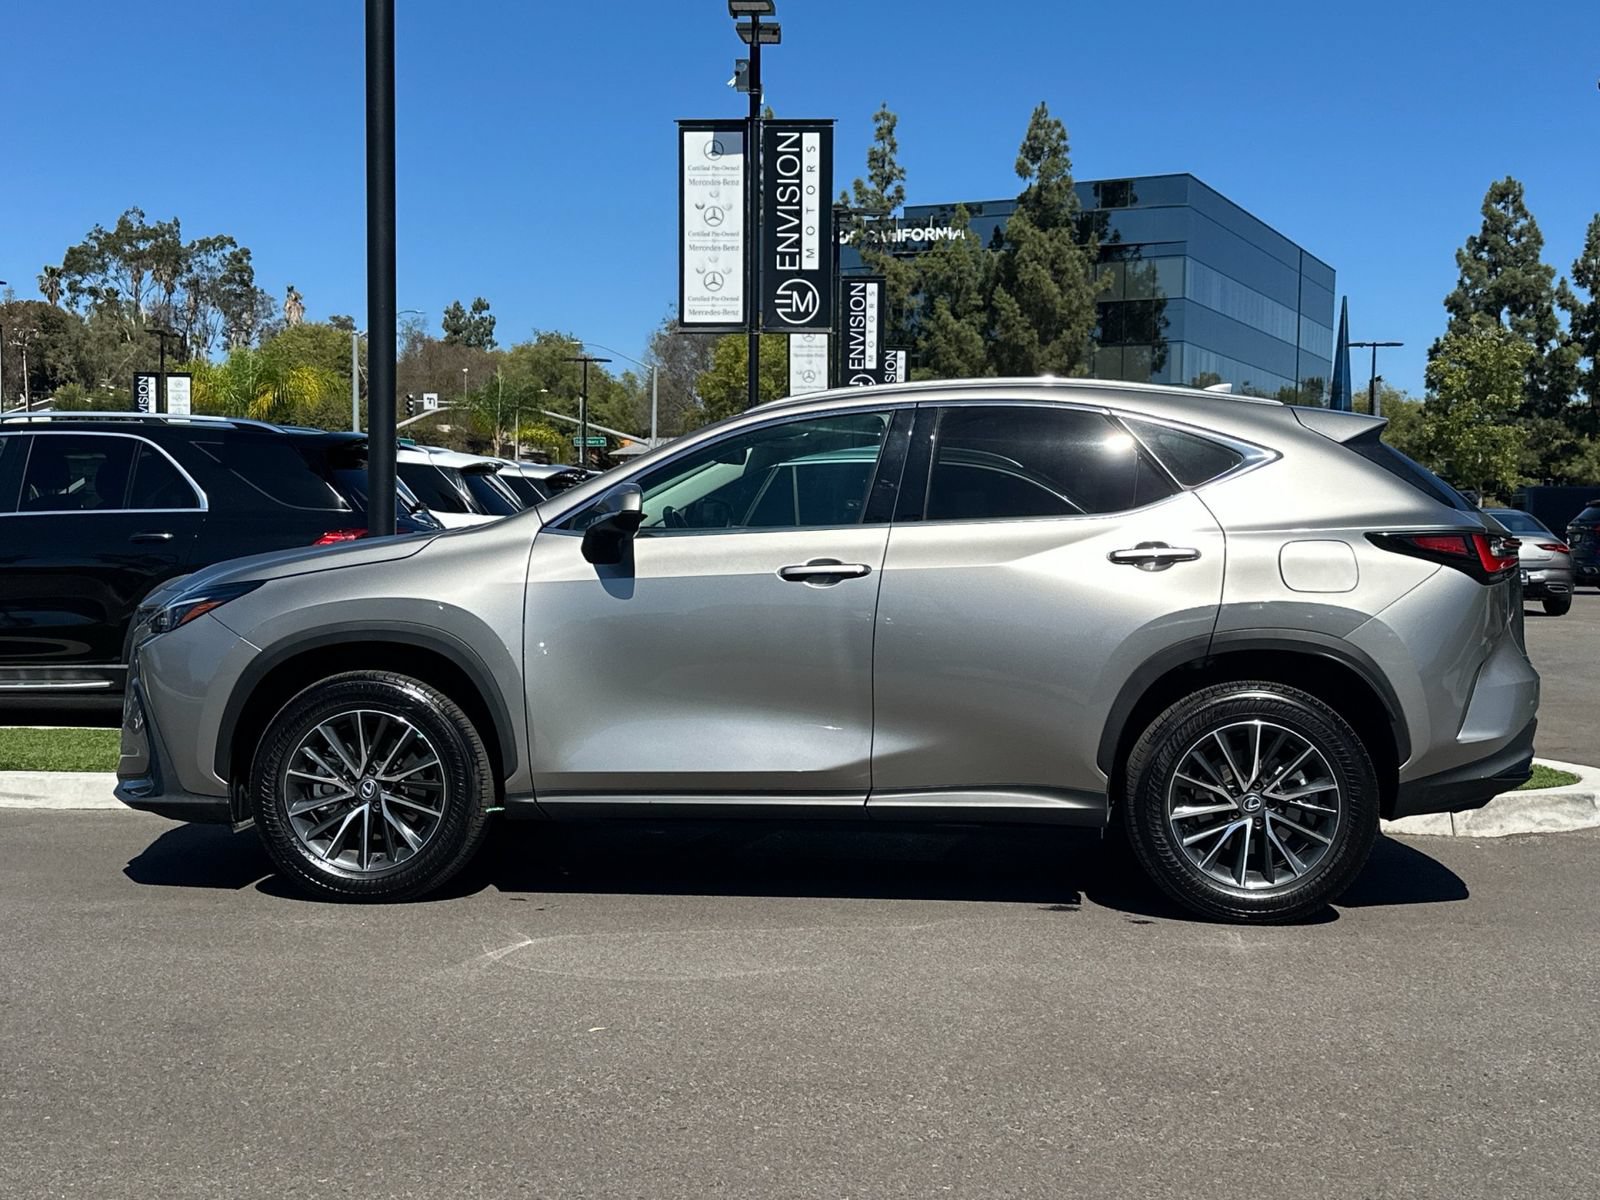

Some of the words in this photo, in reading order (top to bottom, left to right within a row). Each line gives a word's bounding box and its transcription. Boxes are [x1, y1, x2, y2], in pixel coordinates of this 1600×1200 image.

[776, 132, 800, 270] ENVISION
[806, 145, 816, 259] MOTORS
[848, 282, 866, 370] ENVISION
[867, 291, 876, 362] MOTORS
[138, 375, 149, 413] VISION
[884, 350, 897, 383] SION
